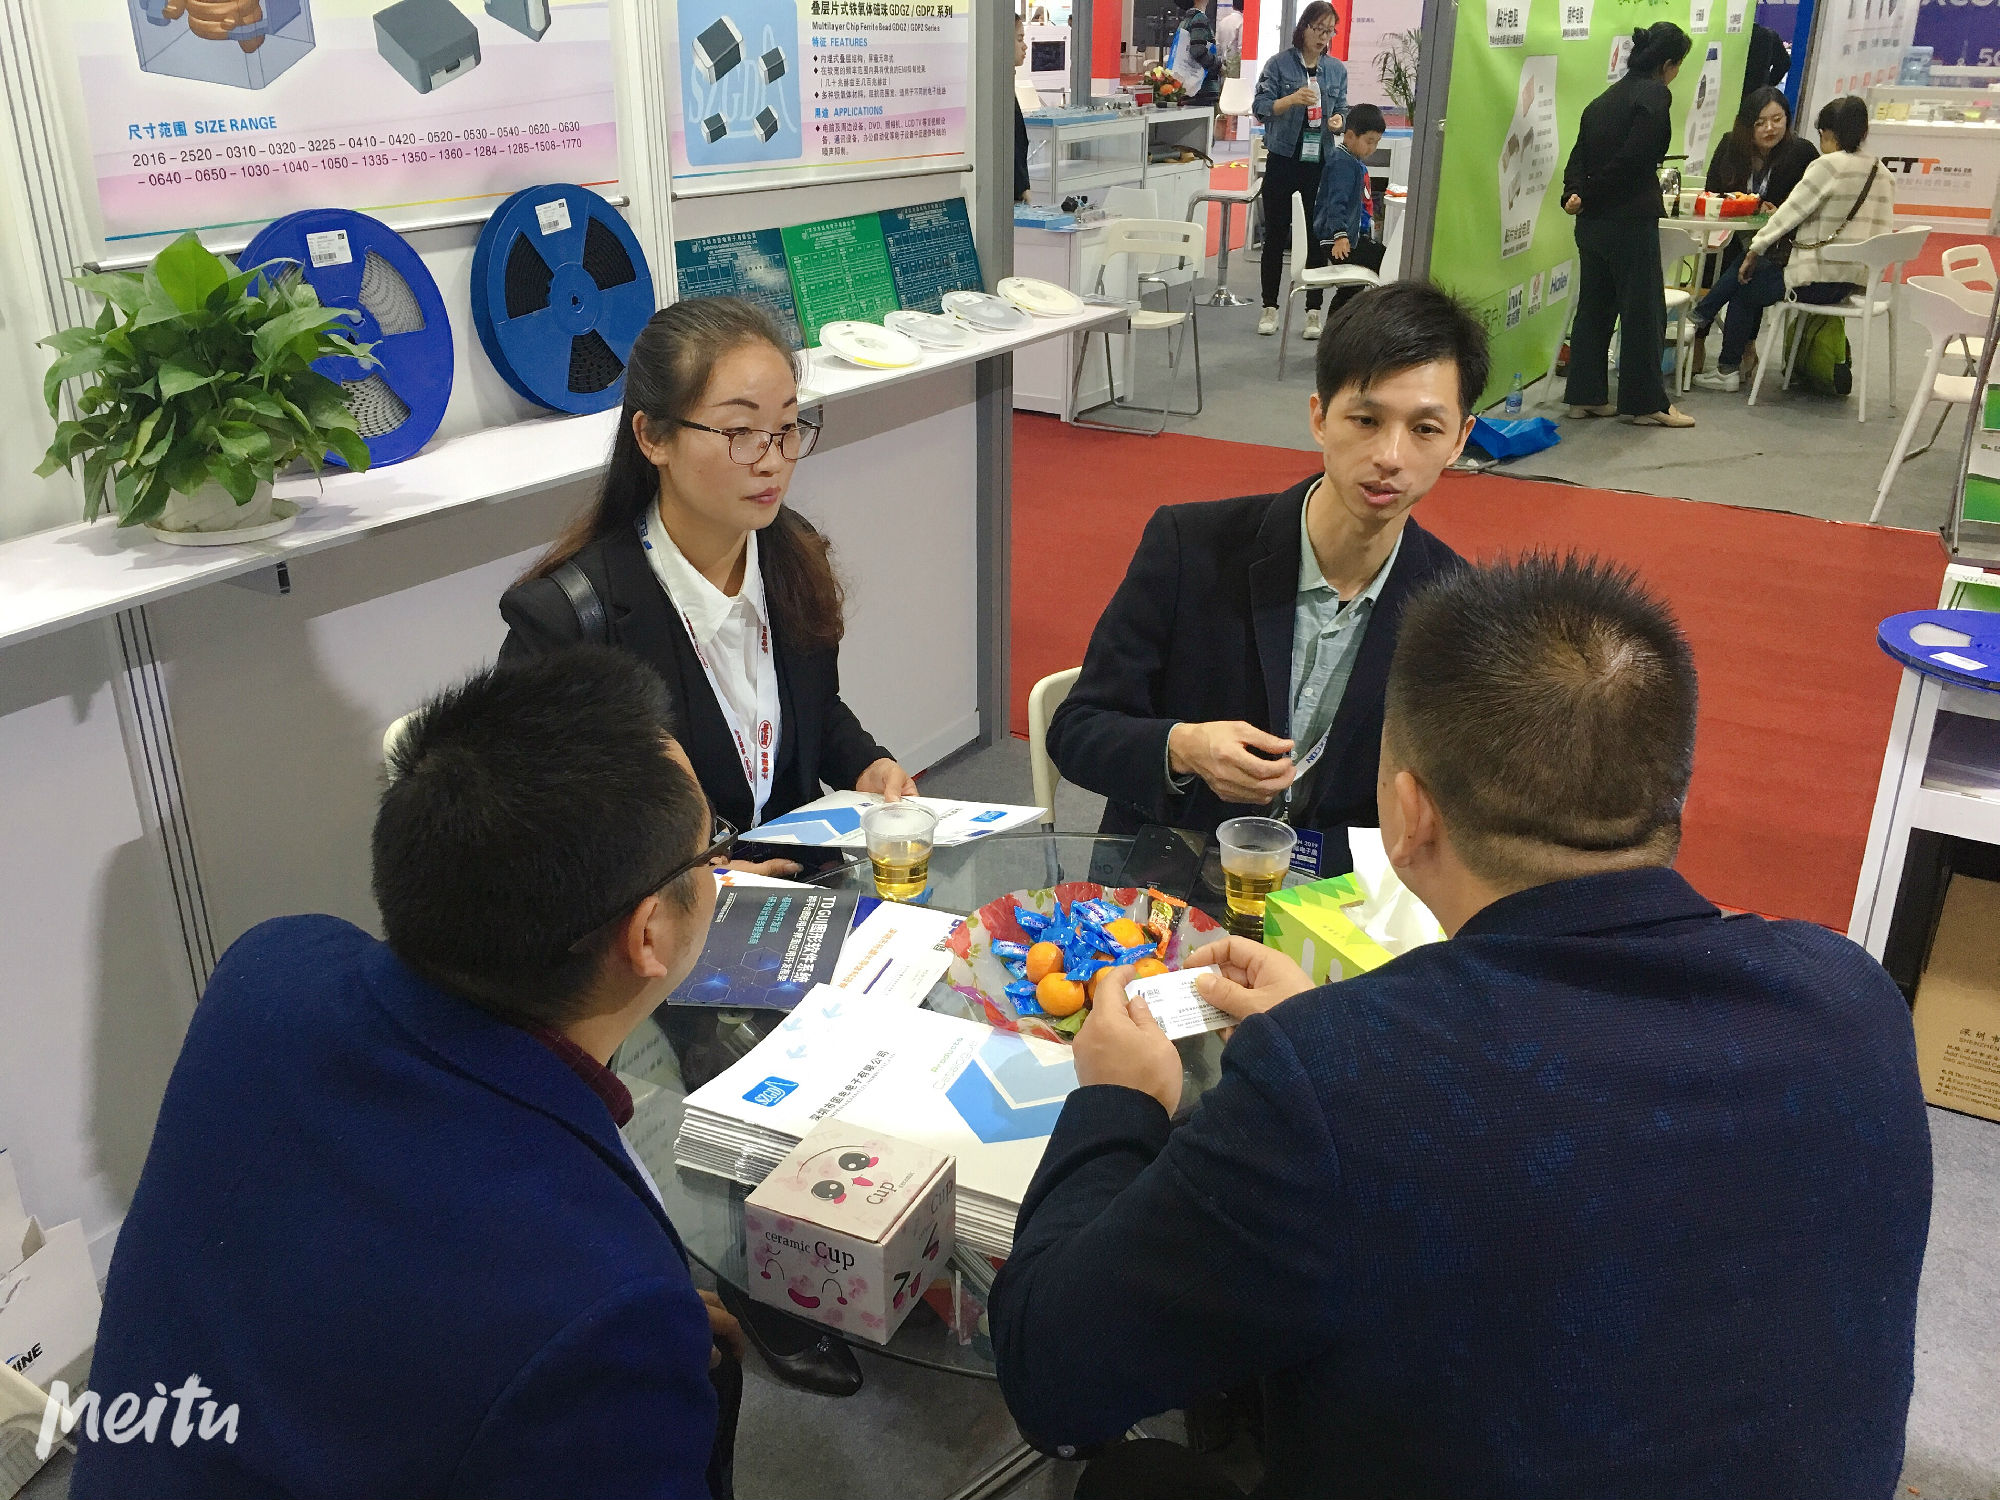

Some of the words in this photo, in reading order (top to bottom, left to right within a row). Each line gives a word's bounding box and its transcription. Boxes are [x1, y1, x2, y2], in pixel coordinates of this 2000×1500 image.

[812, 22, 845, 31] Multilayer
[846, 22, 860, 32] Chip
[812, 37, 827, 48] 特征
[831, 38, 868, 47] FEATURES
[833, 106, 884, 117] APPLICATIONS
[128, 121, 188, 140] 尺寸范围
[195, 120, 227, 135] SIZE
[230, 116, 277, 132] RANGE
[133, 153, 166, 167] 2016
[181, 148, 212, 163] 2520
[226, 145, 256, 159] 0310
[268, 142, 296, 155] 0320
[308, 139, 336, 151] 3225
[348, 136, 377, 148] 0410
[388, 133, 416, 145] 0420
[427, 131, 452, 143] 0520
[463, 128, 487, 140] 0530
[497, 126, 520, 138] 0540
[528, 123, 549, 135] 0620
[558, 121, 580, 133] 0630
[148, 172, 181, 186] 0640
[195, 168, 227, 182] 0650
[241, 164, 270, 178] 1030
[282, 160, 309, 174] 1040
[321, 157, 348, 170] 1050
[362, 154, 389, 167] 1335
[402, 152, 427, 164] 1350
[439, 149, 463, 160] 1360
[474, 146, 497, 157] 1284
[866, 1181, 897, 1205] Cup
[765, 1229, 811, 1255] ceramic
[814, 1241, 856, 1271] Cup
